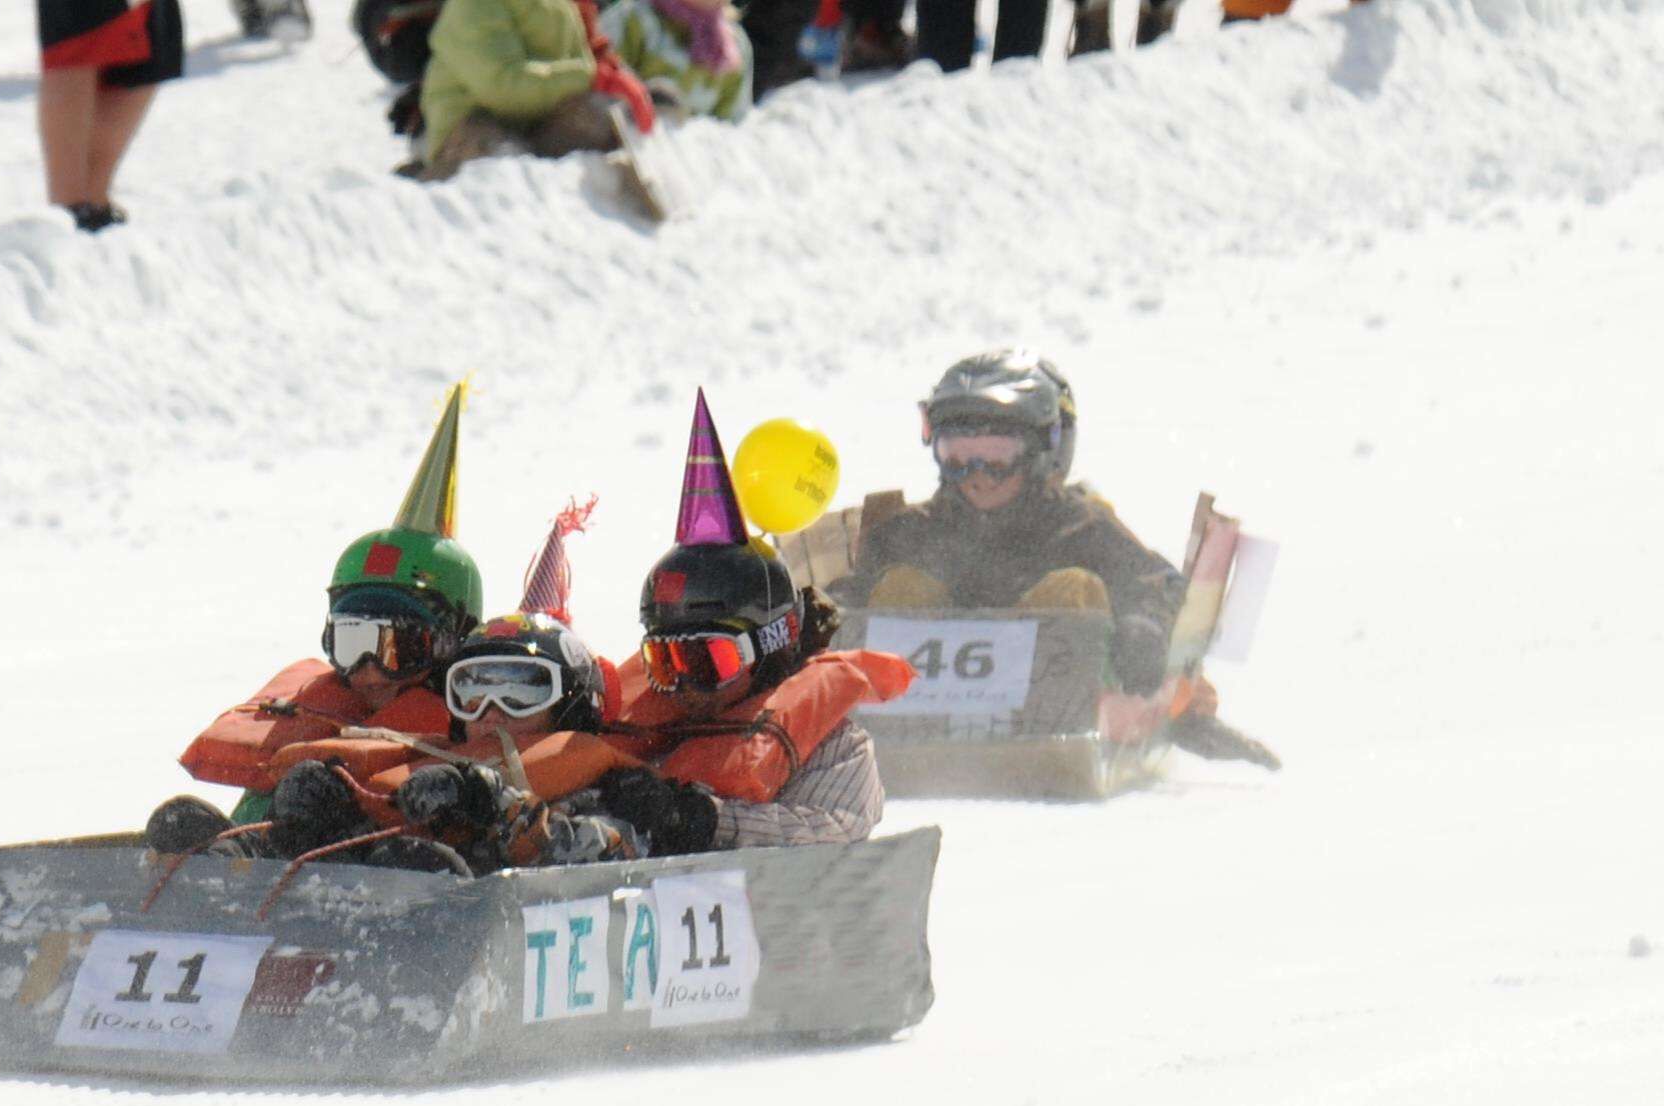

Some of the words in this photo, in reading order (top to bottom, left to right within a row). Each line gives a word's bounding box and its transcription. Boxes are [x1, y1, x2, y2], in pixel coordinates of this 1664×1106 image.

[909, 638, 995, 680] 46
[681, 902, 731, 972] 11
[114, 949, 208, 1003] 11
